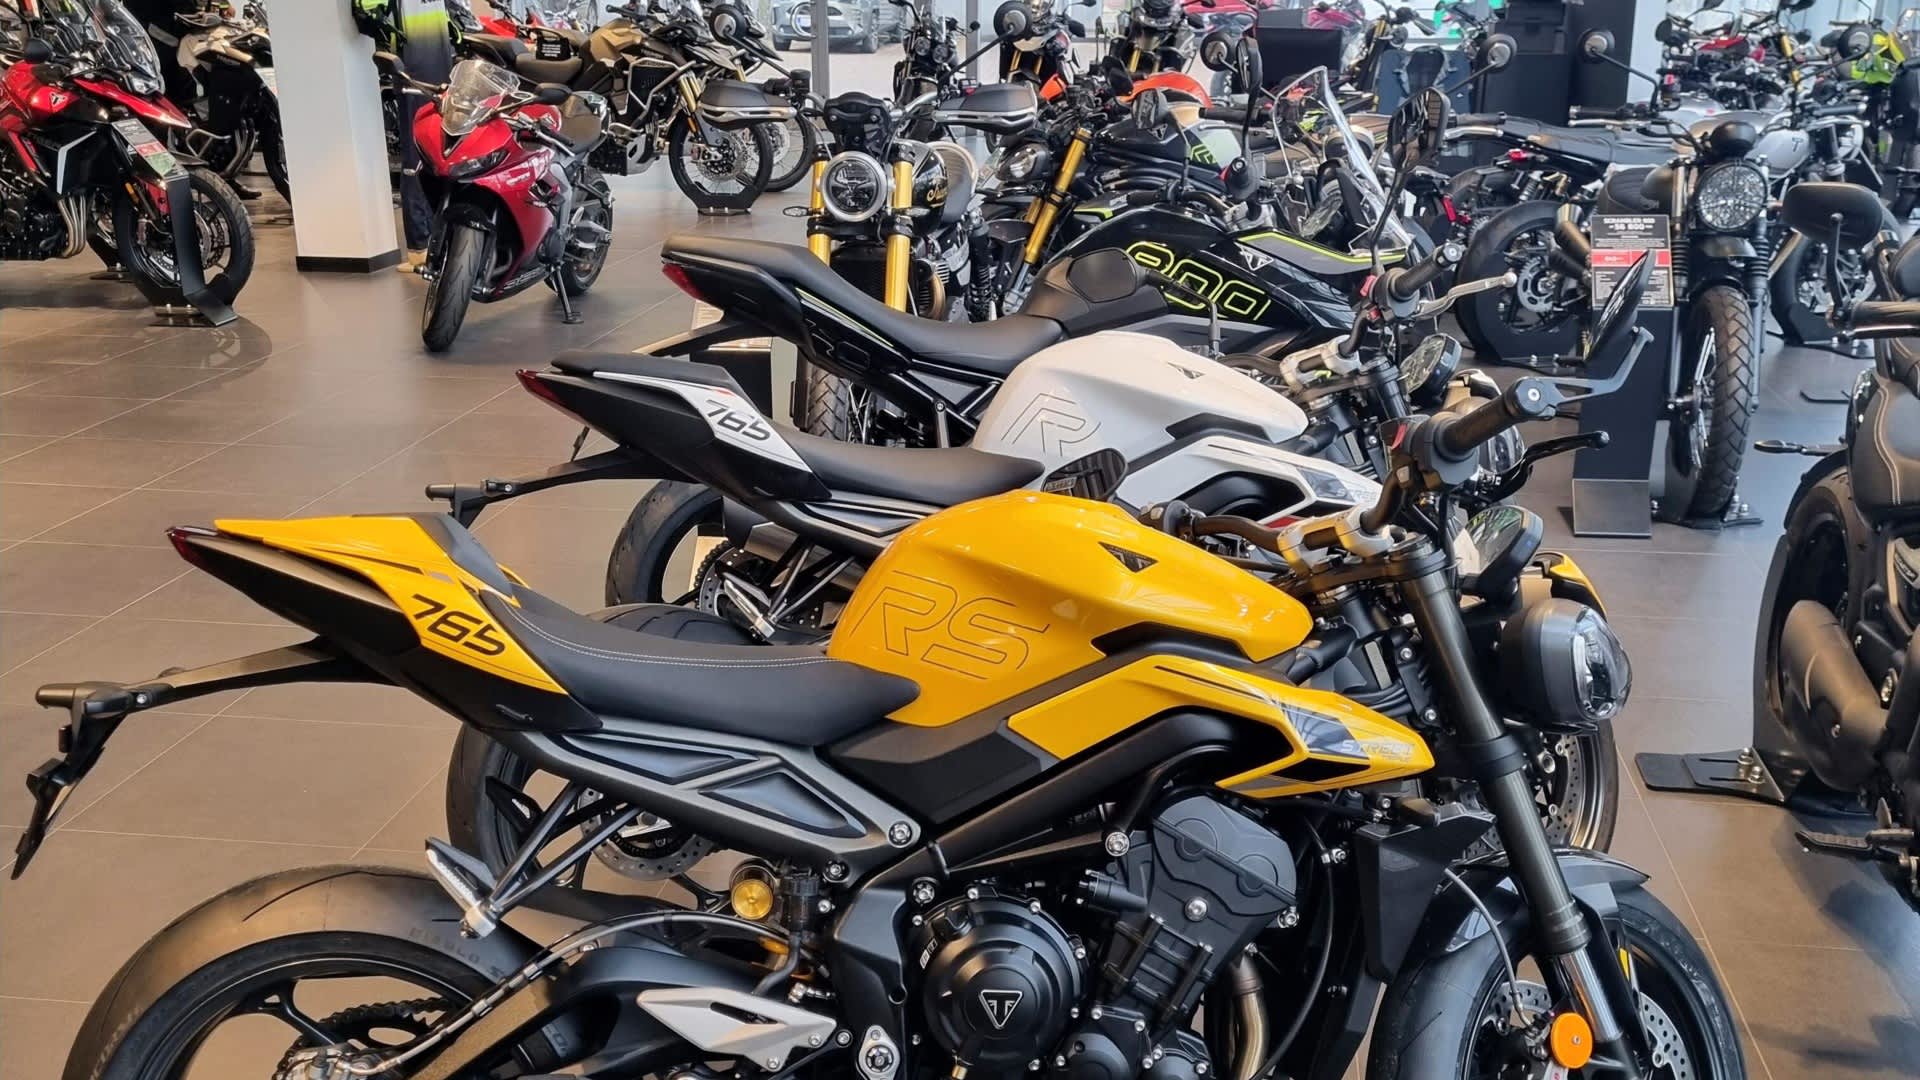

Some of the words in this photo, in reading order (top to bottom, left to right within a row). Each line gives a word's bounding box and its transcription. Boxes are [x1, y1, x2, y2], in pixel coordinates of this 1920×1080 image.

[706, 399, 771, 441] 765
[411, 593, 506, 656] 765
[849, 569, 1051, 680] RS
